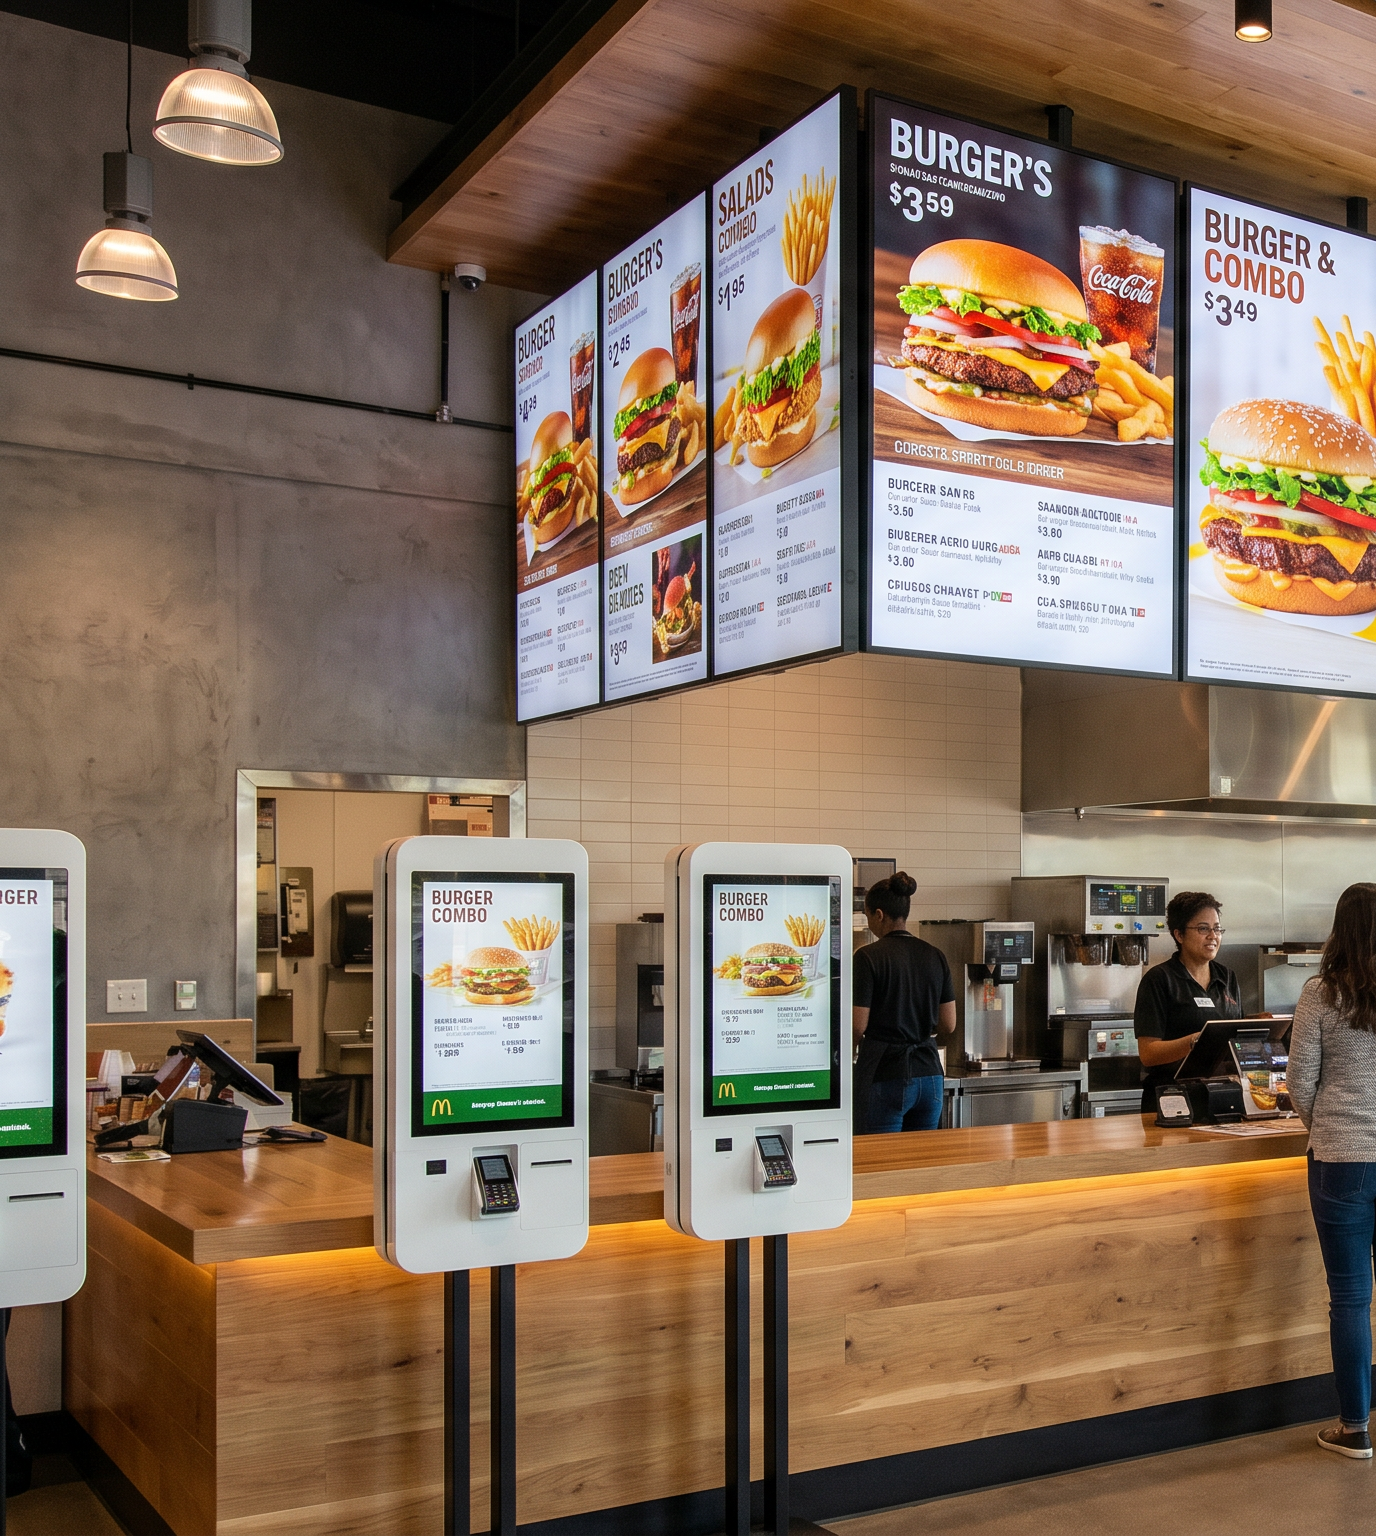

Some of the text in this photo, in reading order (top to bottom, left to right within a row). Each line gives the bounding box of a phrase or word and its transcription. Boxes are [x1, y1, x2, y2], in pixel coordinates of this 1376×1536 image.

[891, 118, 1053, 198] BURGER'S
[718, 159, 774, 226] SALADS
[1205, 207, 1336, 276] BURGER &
[608, 238, 663, 303] BURGER'S
[1204, 248, 1305, 305] COMBO
[518, 314, 556, 364] BURGER
[887, 503, 914, 518] $3.50
[1037, 525, 1063, 539] $3.80
[1037, 573, 1061, 586] $3.90
[0, 889, 38, 905] GER
[432, 890, 493, 905] BURGER
[719, 892, 768, 906] BURGER
[432, 907, 488, 923] COMBO
[719, 908, 764, 921] COMBO
